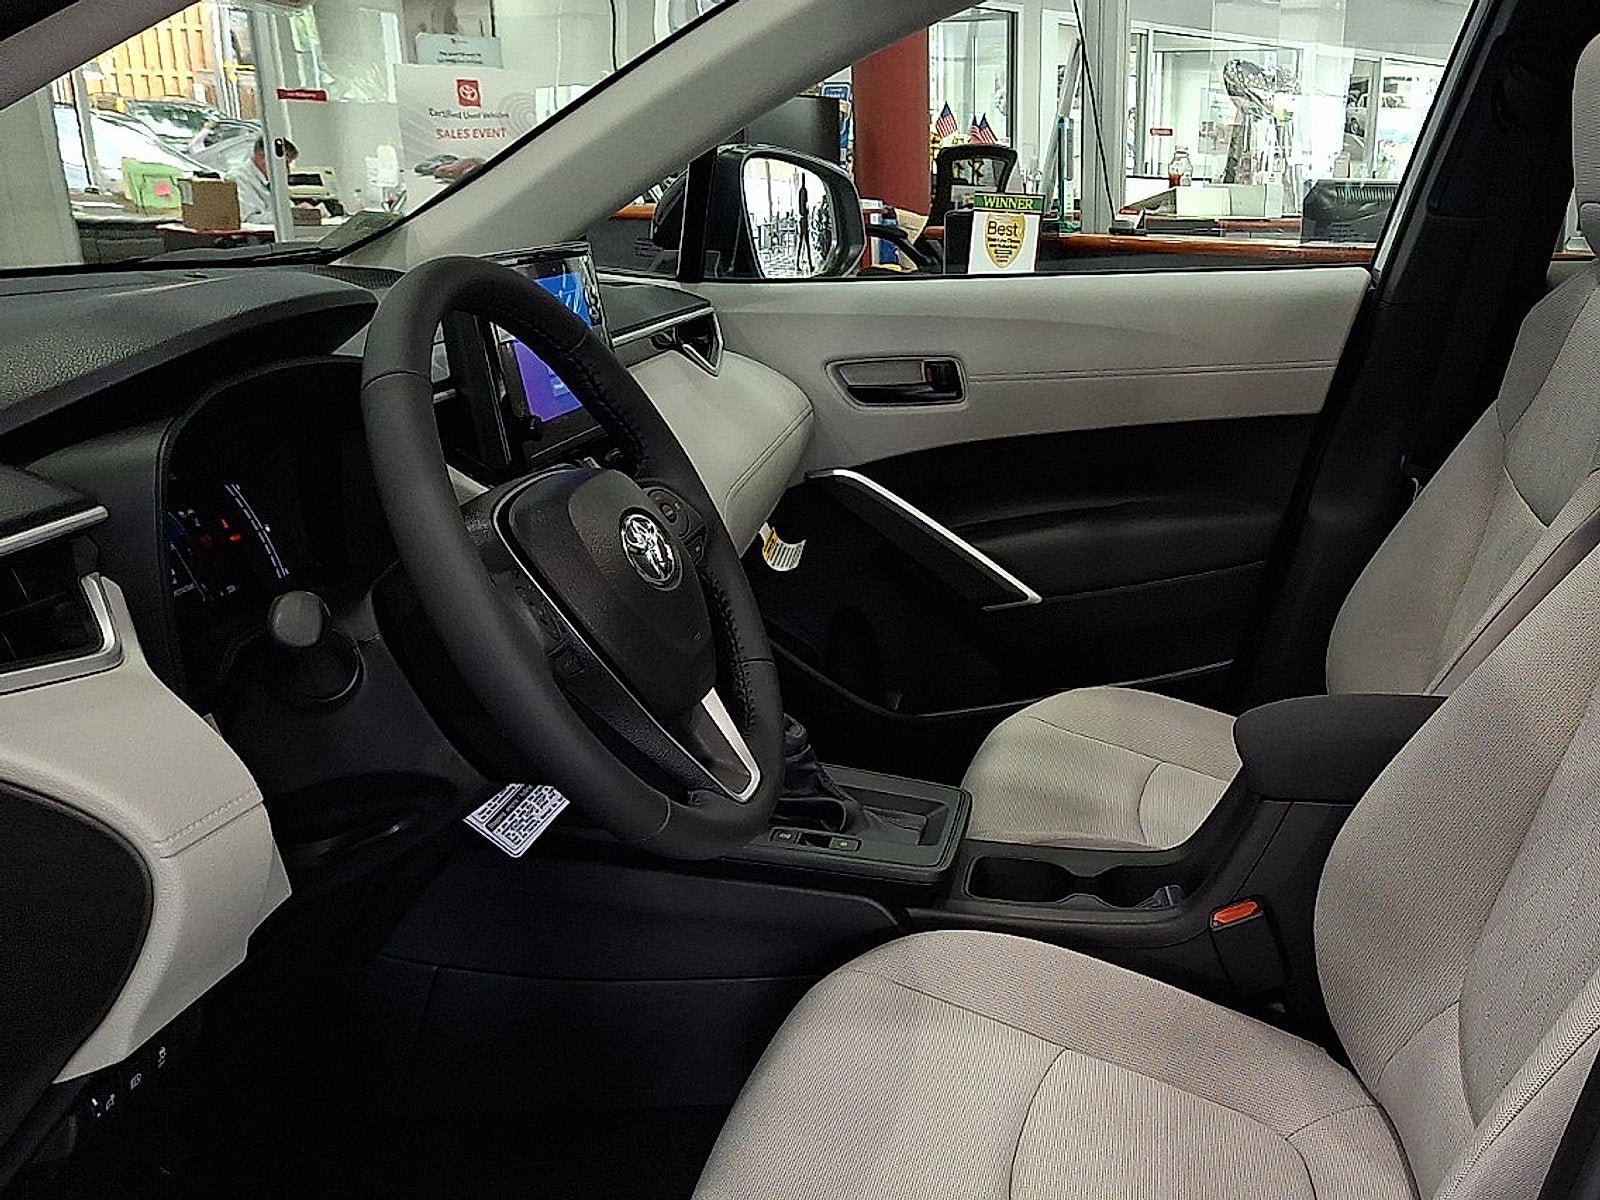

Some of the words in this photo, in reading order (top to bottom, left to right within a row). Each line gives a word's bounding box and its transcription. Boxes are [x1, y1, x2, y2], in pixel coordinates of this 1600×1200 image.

[436, 128, 471, 139] SALES
[473, 127, 507, 139] EVENT
[983, 195, 1034, 210] WINNER
[987, 221, 1018, 237] Best
